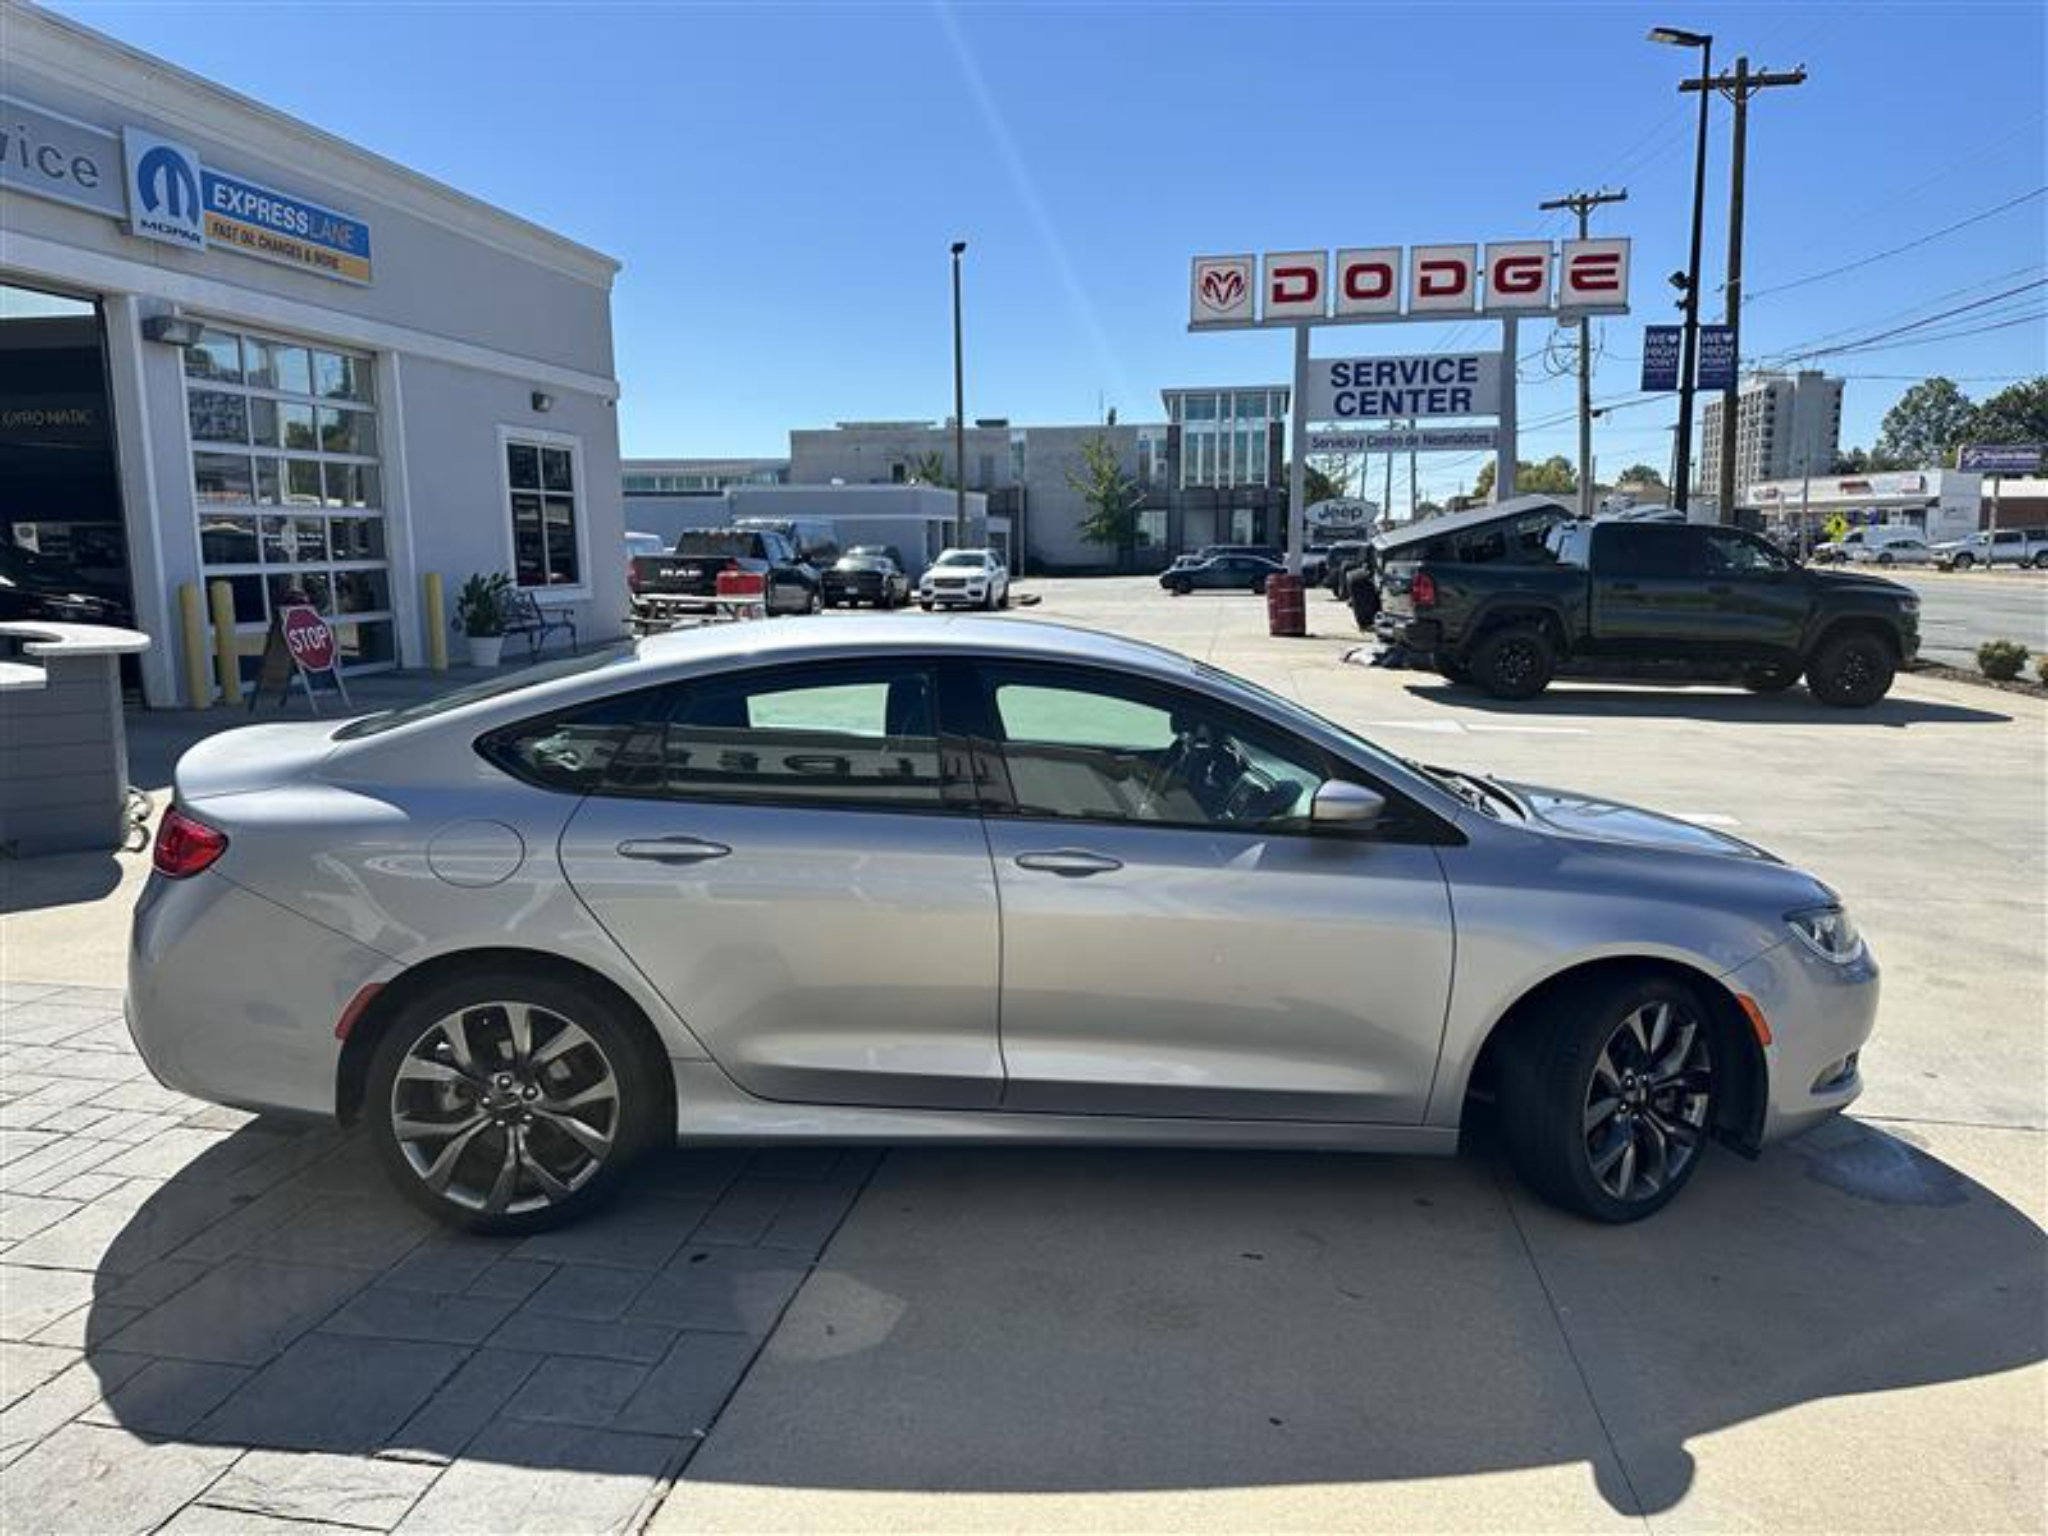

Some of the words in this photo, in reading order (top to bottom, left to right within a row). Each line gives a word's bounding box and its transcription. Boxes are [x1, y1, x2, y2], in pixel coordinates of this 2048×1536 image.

[141, 219, 201, 244] MOPAR
[212, 221, 237, 243] FAST
[1272, 252, 1621, 304] DODGE
[1648, 333, 1667, 344] WE
[1701, 332, 1720, 344] WE
[1645, 346, 1678, 358] HIGH
[1701, 346, 1734, 358] HIGH
[1644, 358, 1676, 368] POINT
[1700, 358, 1733, 368] POINT
[1330, 357, 1479, 388] SERVICE
[1333, 386, 1473, 416] CENTER
[1312, 436, 1357, 449] Servicio
[1318, 504, 1363, 522] Jeep
[660, 568, 704, 578] RAM
[288, 624, 329, 653] STOP
